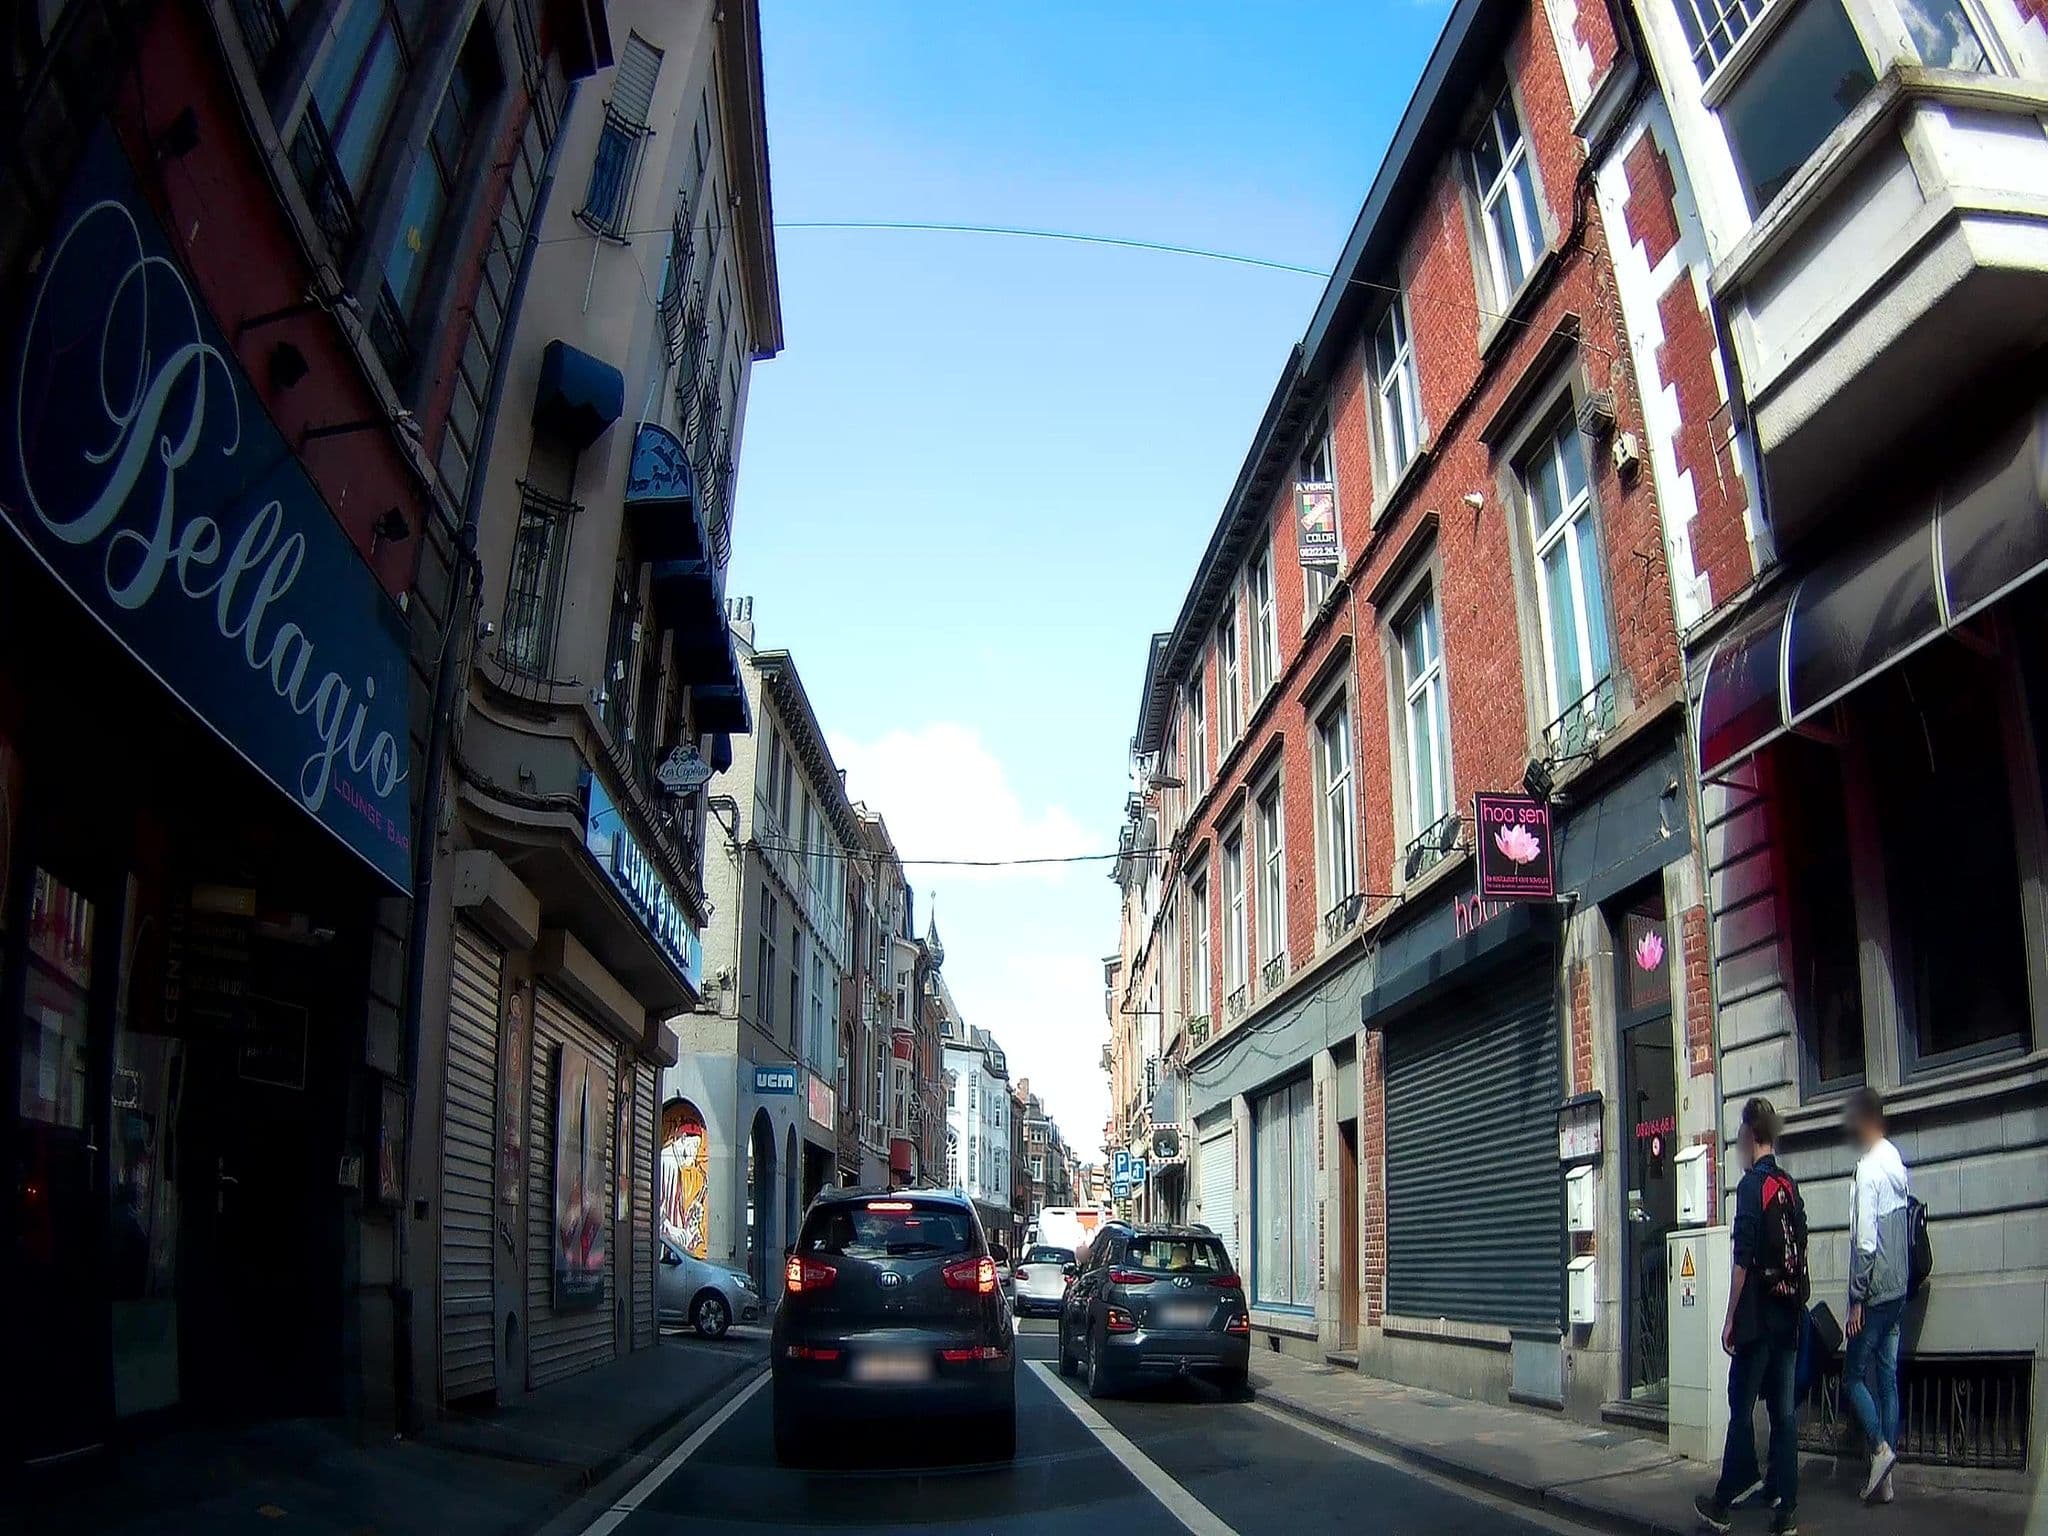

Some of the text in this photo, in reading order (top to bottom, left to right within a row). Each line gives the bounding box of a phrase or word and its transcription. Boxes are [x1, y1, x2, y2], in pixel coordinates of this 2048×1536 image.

[18, 199, 409, 814] Bellagio
[1306, 533, 1336, 543] COLOR
[1483, 803, 1546, 825] hoa sen
[623, 831, 694, 968] LUNA PARK
[1117, 1153, 1127, 1173] P
